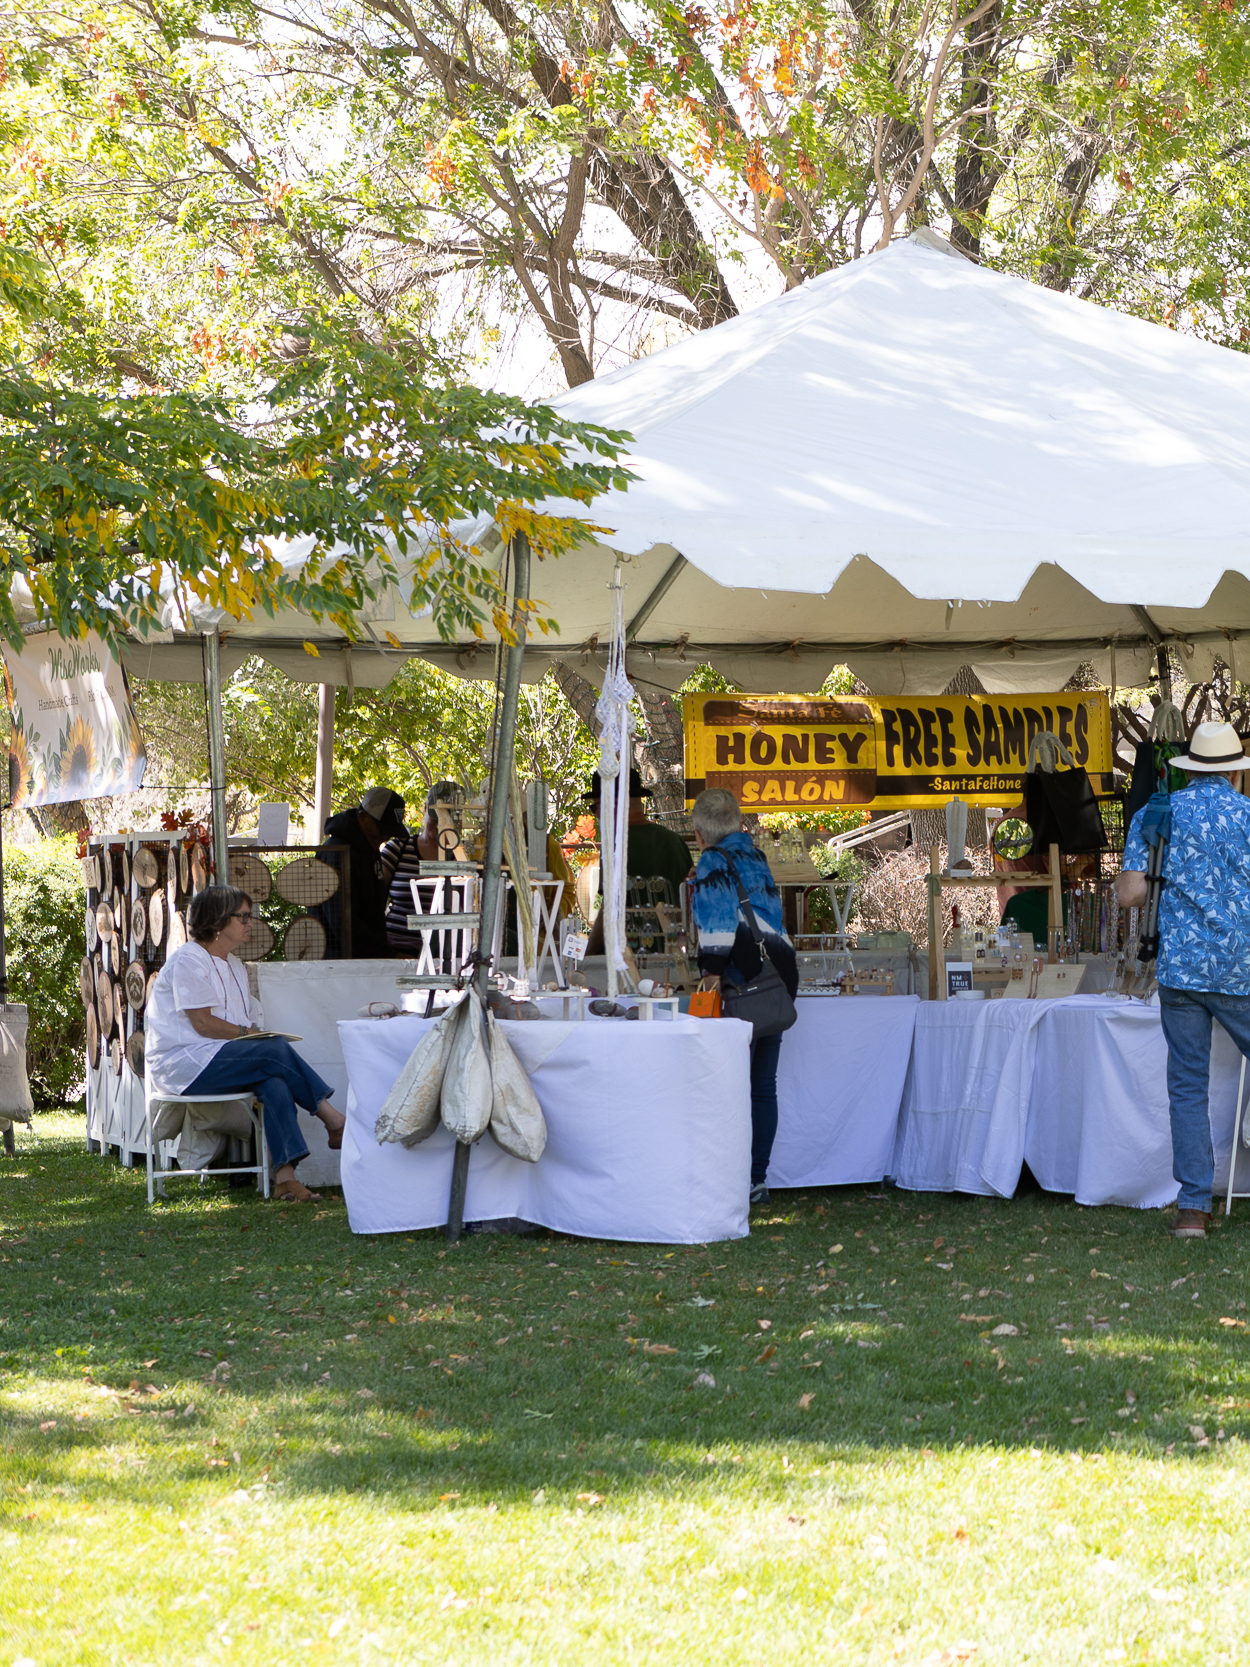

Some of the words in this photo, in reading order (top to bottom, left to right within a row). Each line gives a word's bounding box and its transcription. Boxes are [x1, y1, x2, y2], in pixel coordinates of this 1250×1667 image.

[48, 641, 100, 682] WiseWorks
[738, 703, 809, 719] Santa
[818, 704, 843, 719] Fé
[715, 732, 868, 766] HONEY
[881, 707, 957, 768] FREE
[741, 776, 846, 803] SALÓN
[929, 776, 1022, 791] -SantaFeHone
